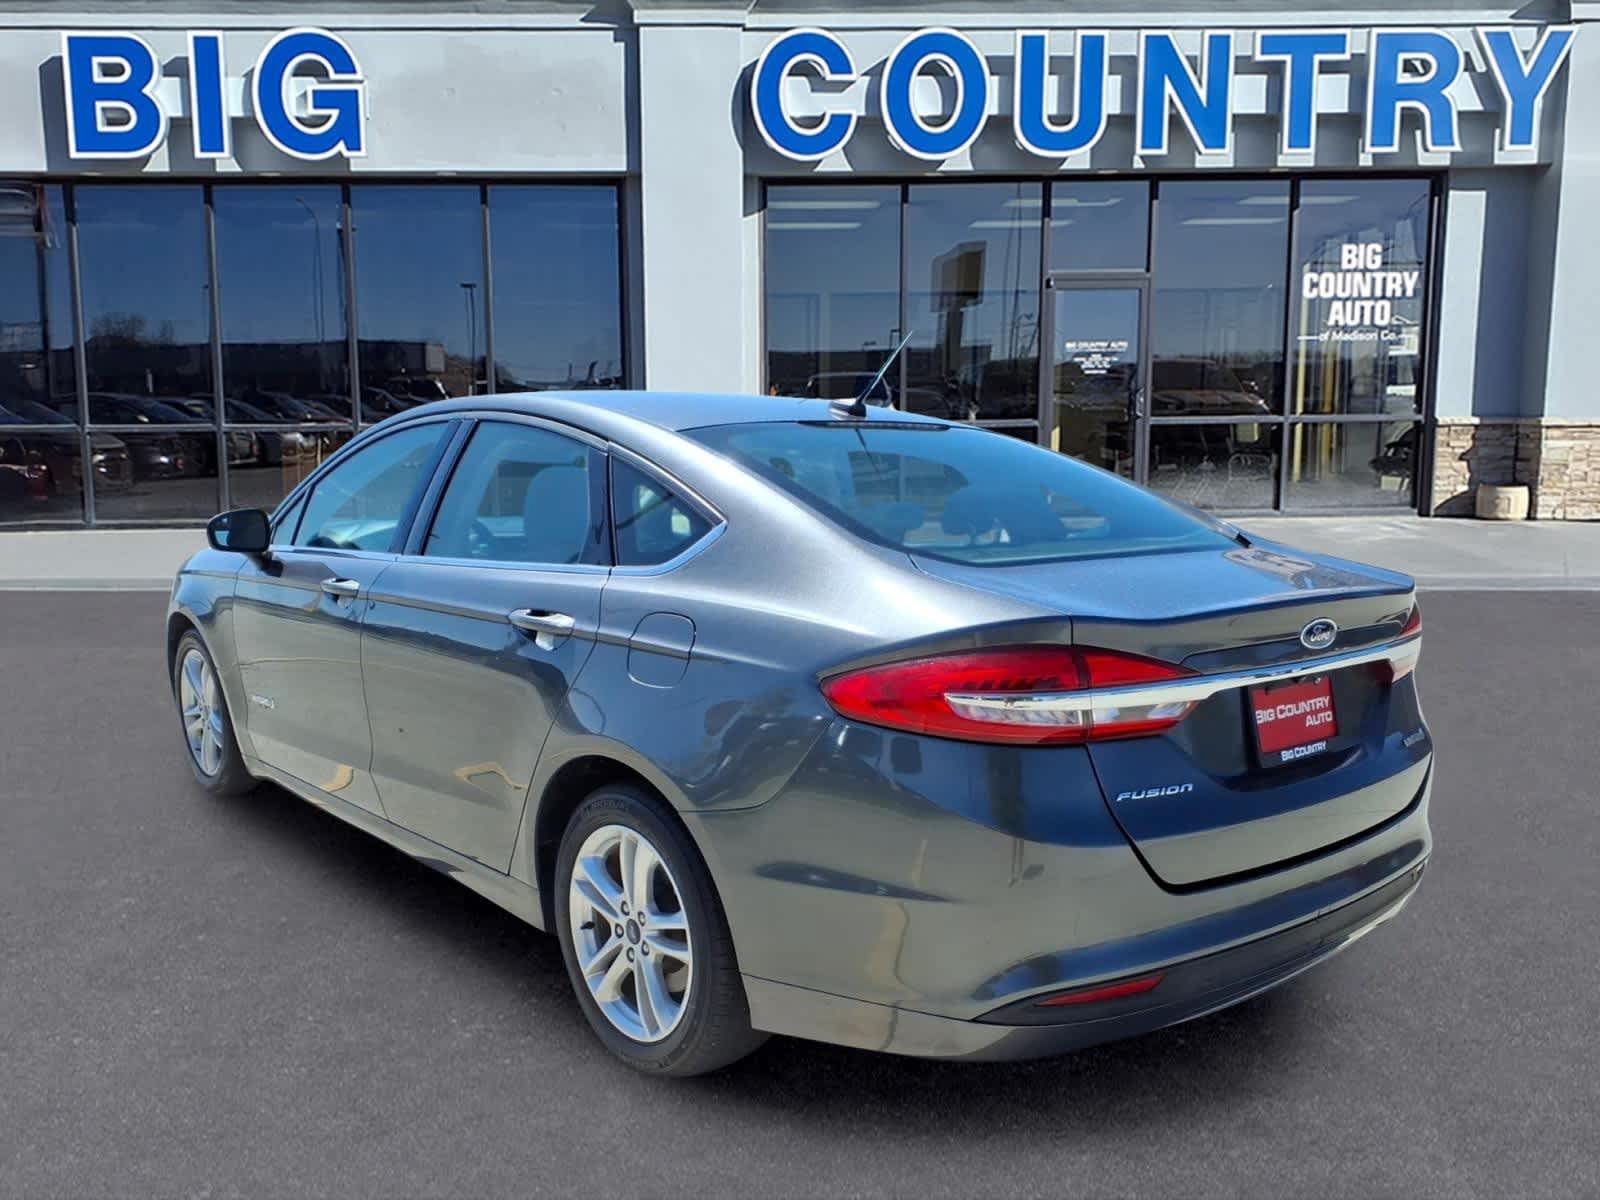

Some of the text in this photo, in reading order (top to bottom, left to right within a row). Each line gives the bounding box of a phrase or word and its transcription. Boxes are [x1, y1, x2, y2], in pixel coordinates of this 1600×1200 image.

[61, 27, 1576, 162] BIG COUNTRY
[1341, 243, 1383, 270] BIG
[1302, 271, 1420, 298] COUNTRY
[1327, 300, 1391, 326] AUTO
[1256, 696, 1330, 725] BIG COUNTRY
[1305, 711, 1333, 728] AUTO
[1281, 740, 1327, 761] BIG COUNTRY
[1116, 783, 1194, 802] FUSION
